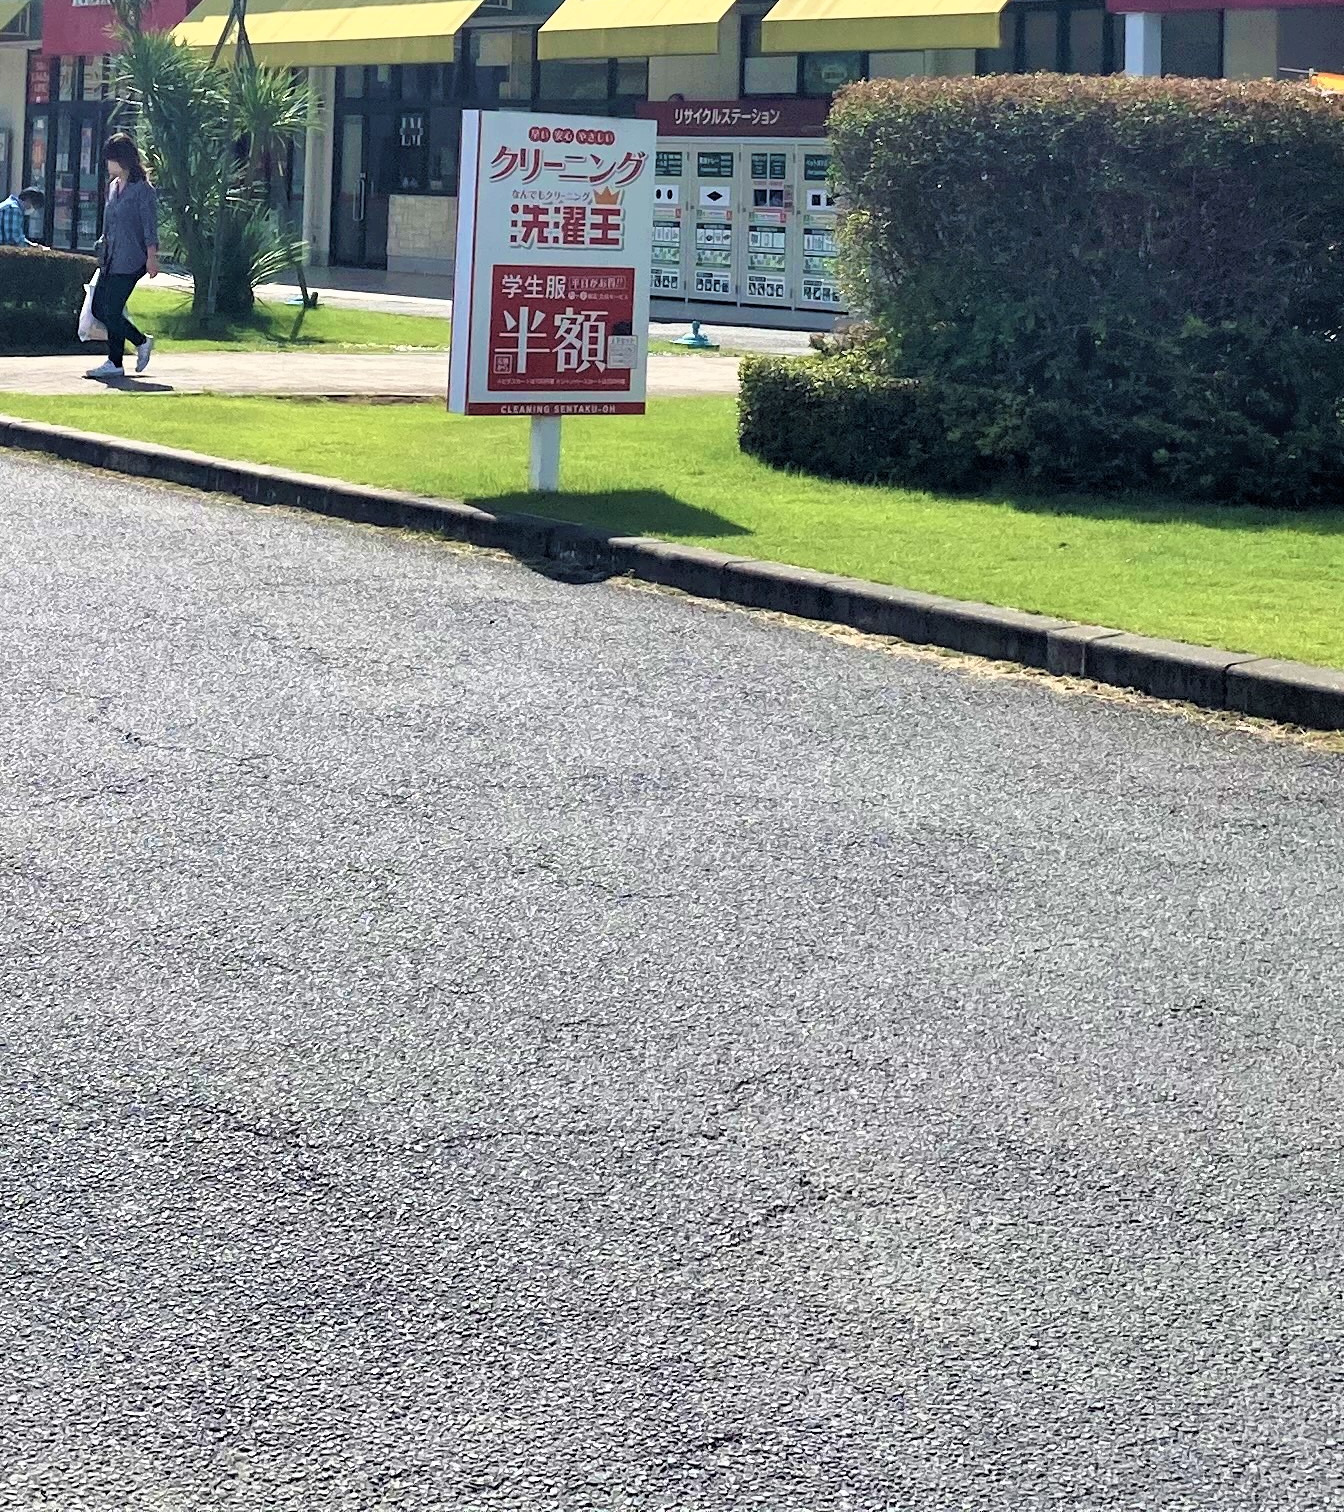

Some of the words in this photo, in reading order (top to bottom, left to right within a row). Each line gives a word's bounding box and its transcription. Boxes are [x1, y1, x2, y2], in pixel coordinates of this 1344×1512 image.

[674, 108, 781, 125] リサイクルステーション
[489, 146, 648, 187] クリーニング
[510, 204, 623, 248] 洗濯王
[501, 274, 566, 299] 学生服
[494, 306, 609, 374] 半額
[500, 404, 550, 414] CLEANING
[554, 405, 616, 415] SENTAKU-OH
